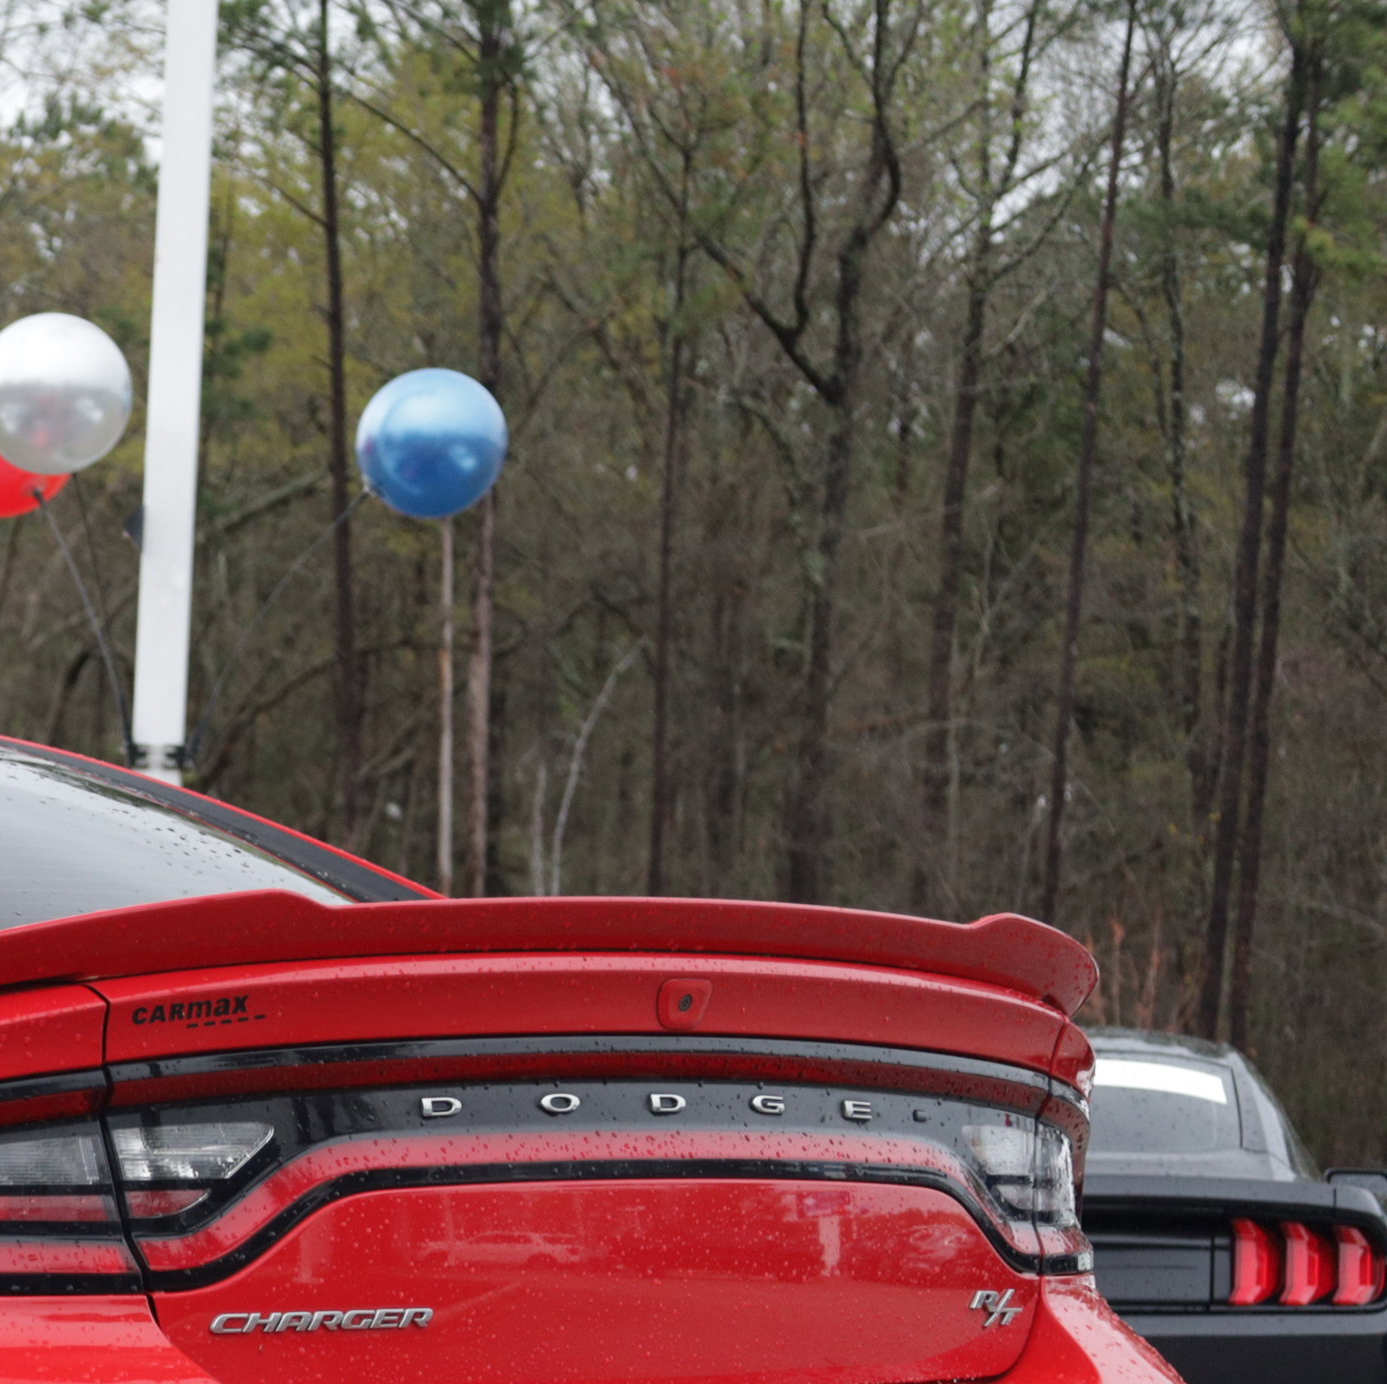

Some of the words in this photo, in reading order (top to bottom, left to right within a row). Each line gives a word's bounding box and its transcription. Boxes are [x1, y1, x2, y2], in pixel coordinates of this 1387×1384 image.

[421, 1093, 873, 1121] DODGE
[210, 1307, 434, 1334] CHARGER
[970, 1288, 1023, 1327] R/T
